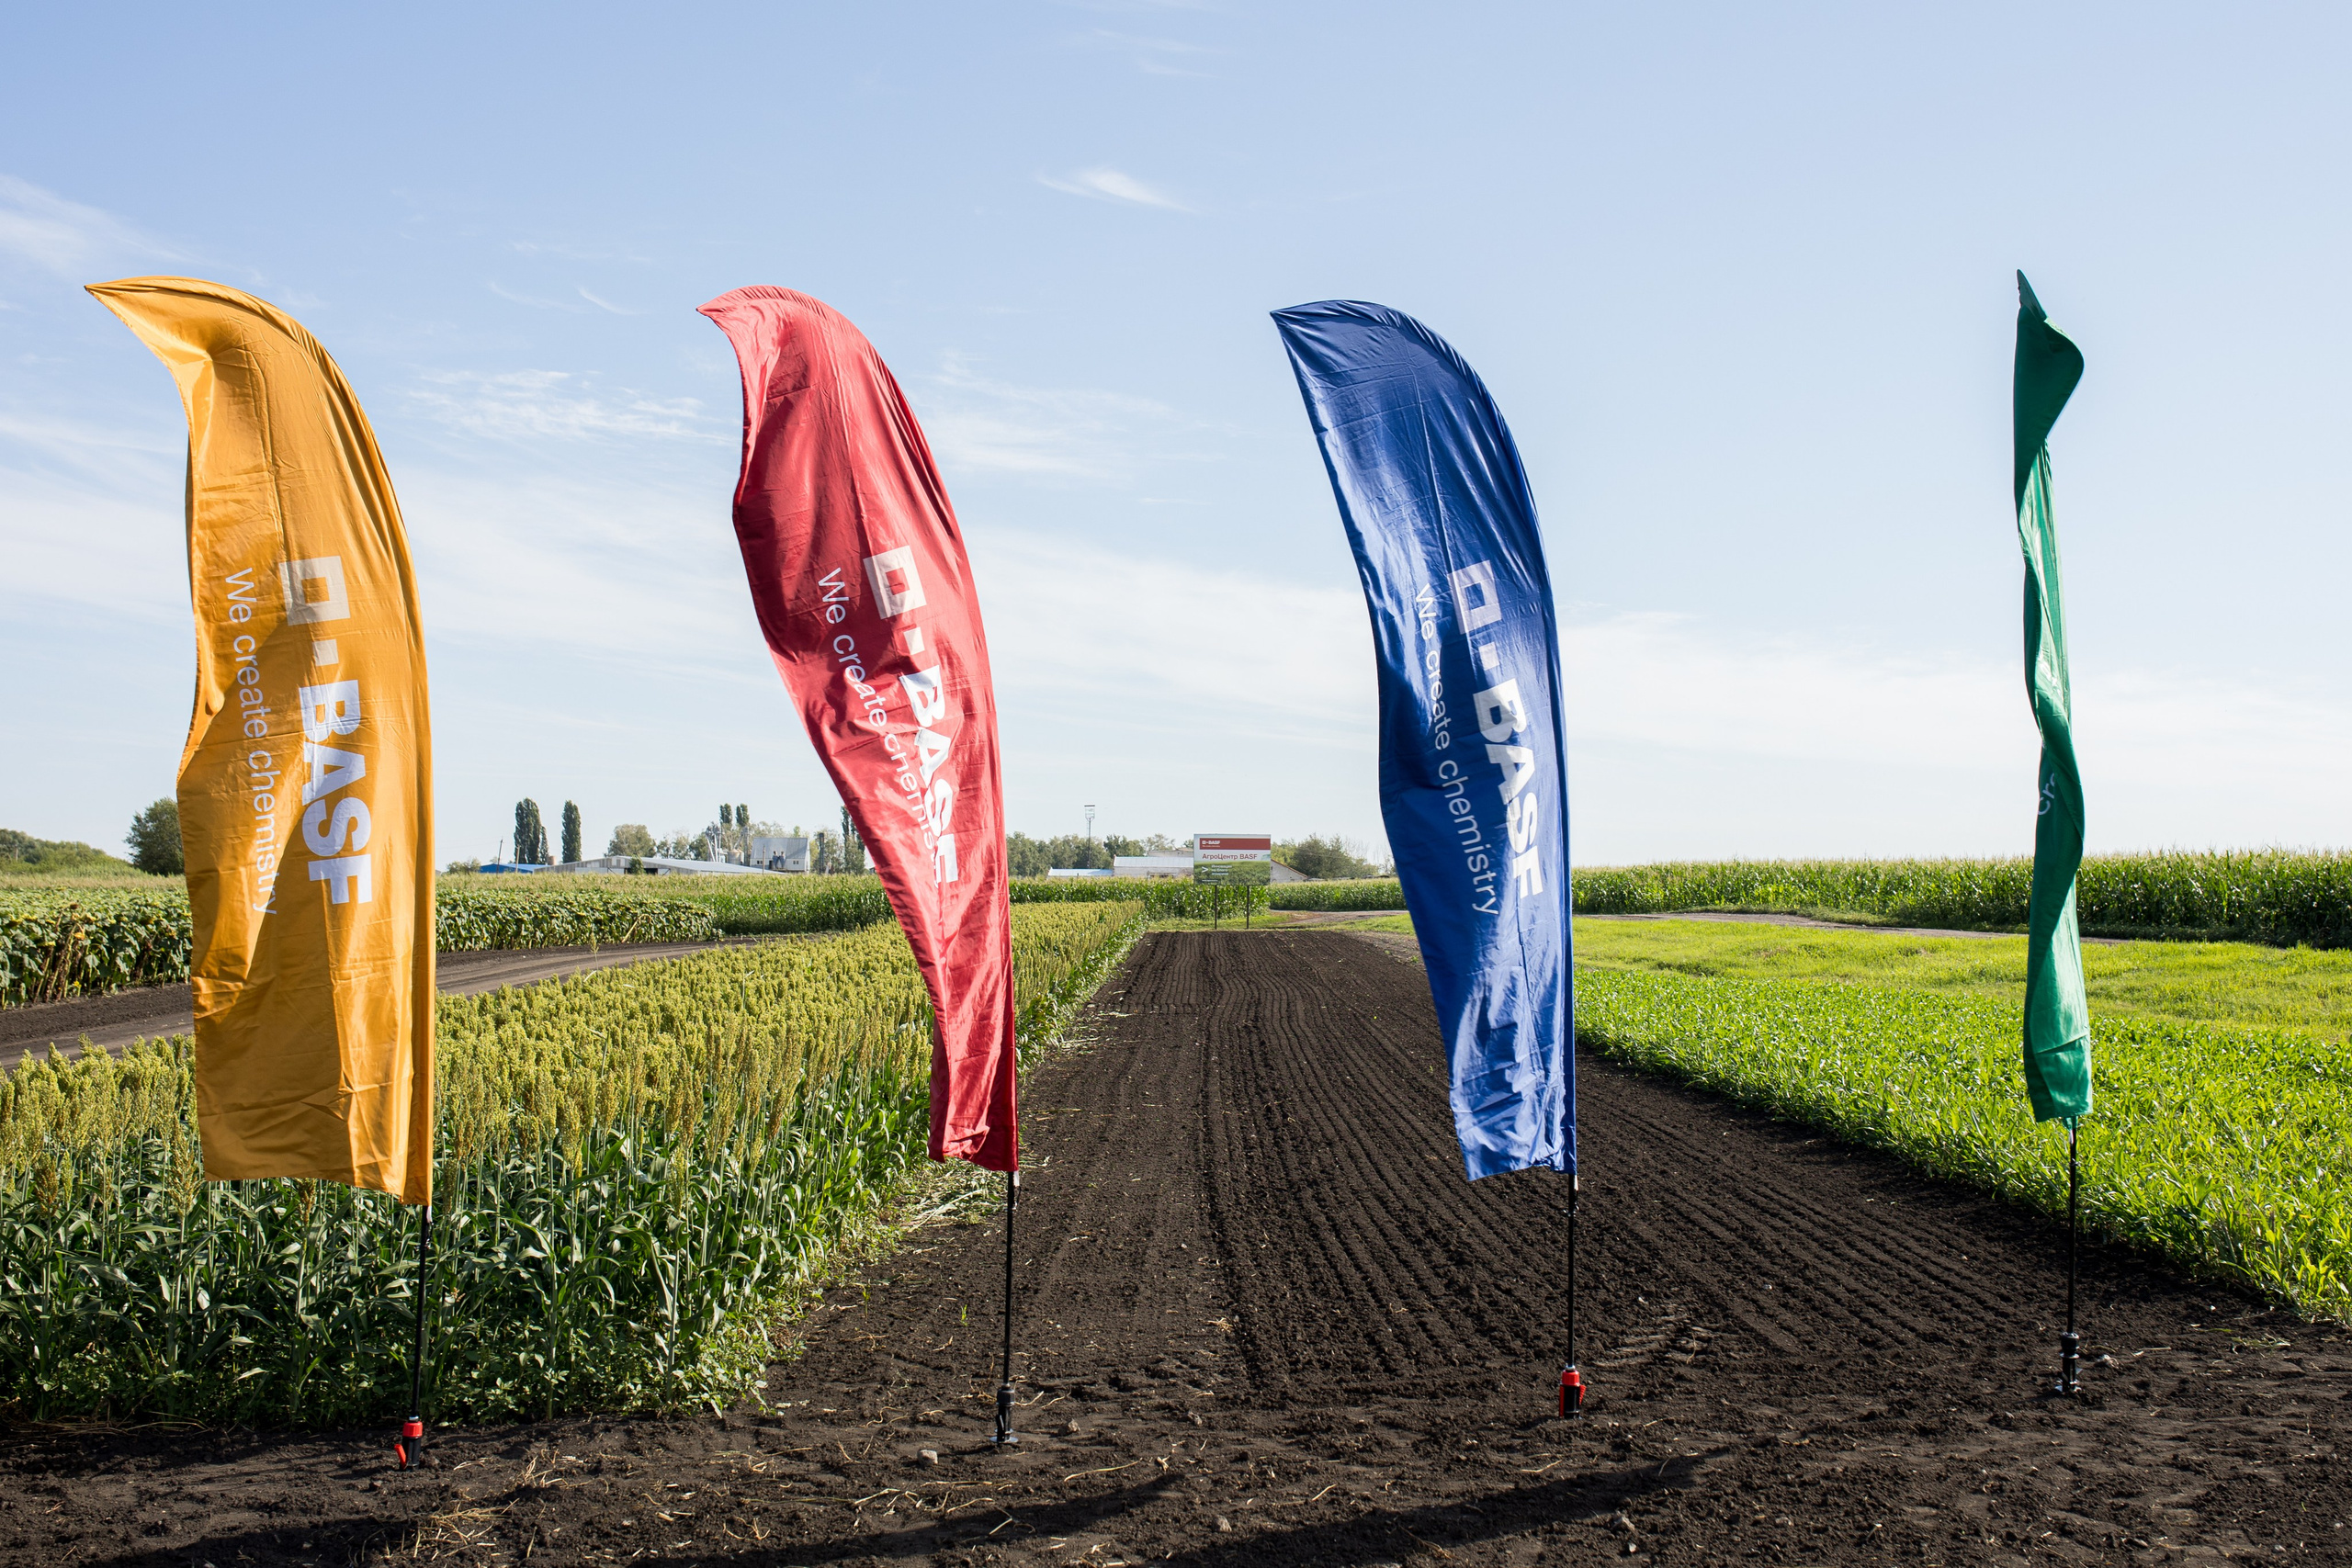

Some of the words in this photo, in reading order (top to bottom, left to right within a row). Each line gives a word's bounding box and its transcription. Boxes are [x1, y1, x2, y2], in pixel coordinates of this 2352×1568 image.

[225, 567, 257, 624] We
[818, 567, 850, 625] We
[1414, 582, 1437, 640] We
[233, 636, 271, 739] create
[833, 634, 888, 728] create
[1425, 649, 1452, 750] create
[299, 679, 373, 905] BASF
[899, 664, 958, 884] BASF
[1472, 678, 1544, 898] BASF
[247, 750, 285, 915] chemistry
[1438, 760, 1498, 915] chemistry
